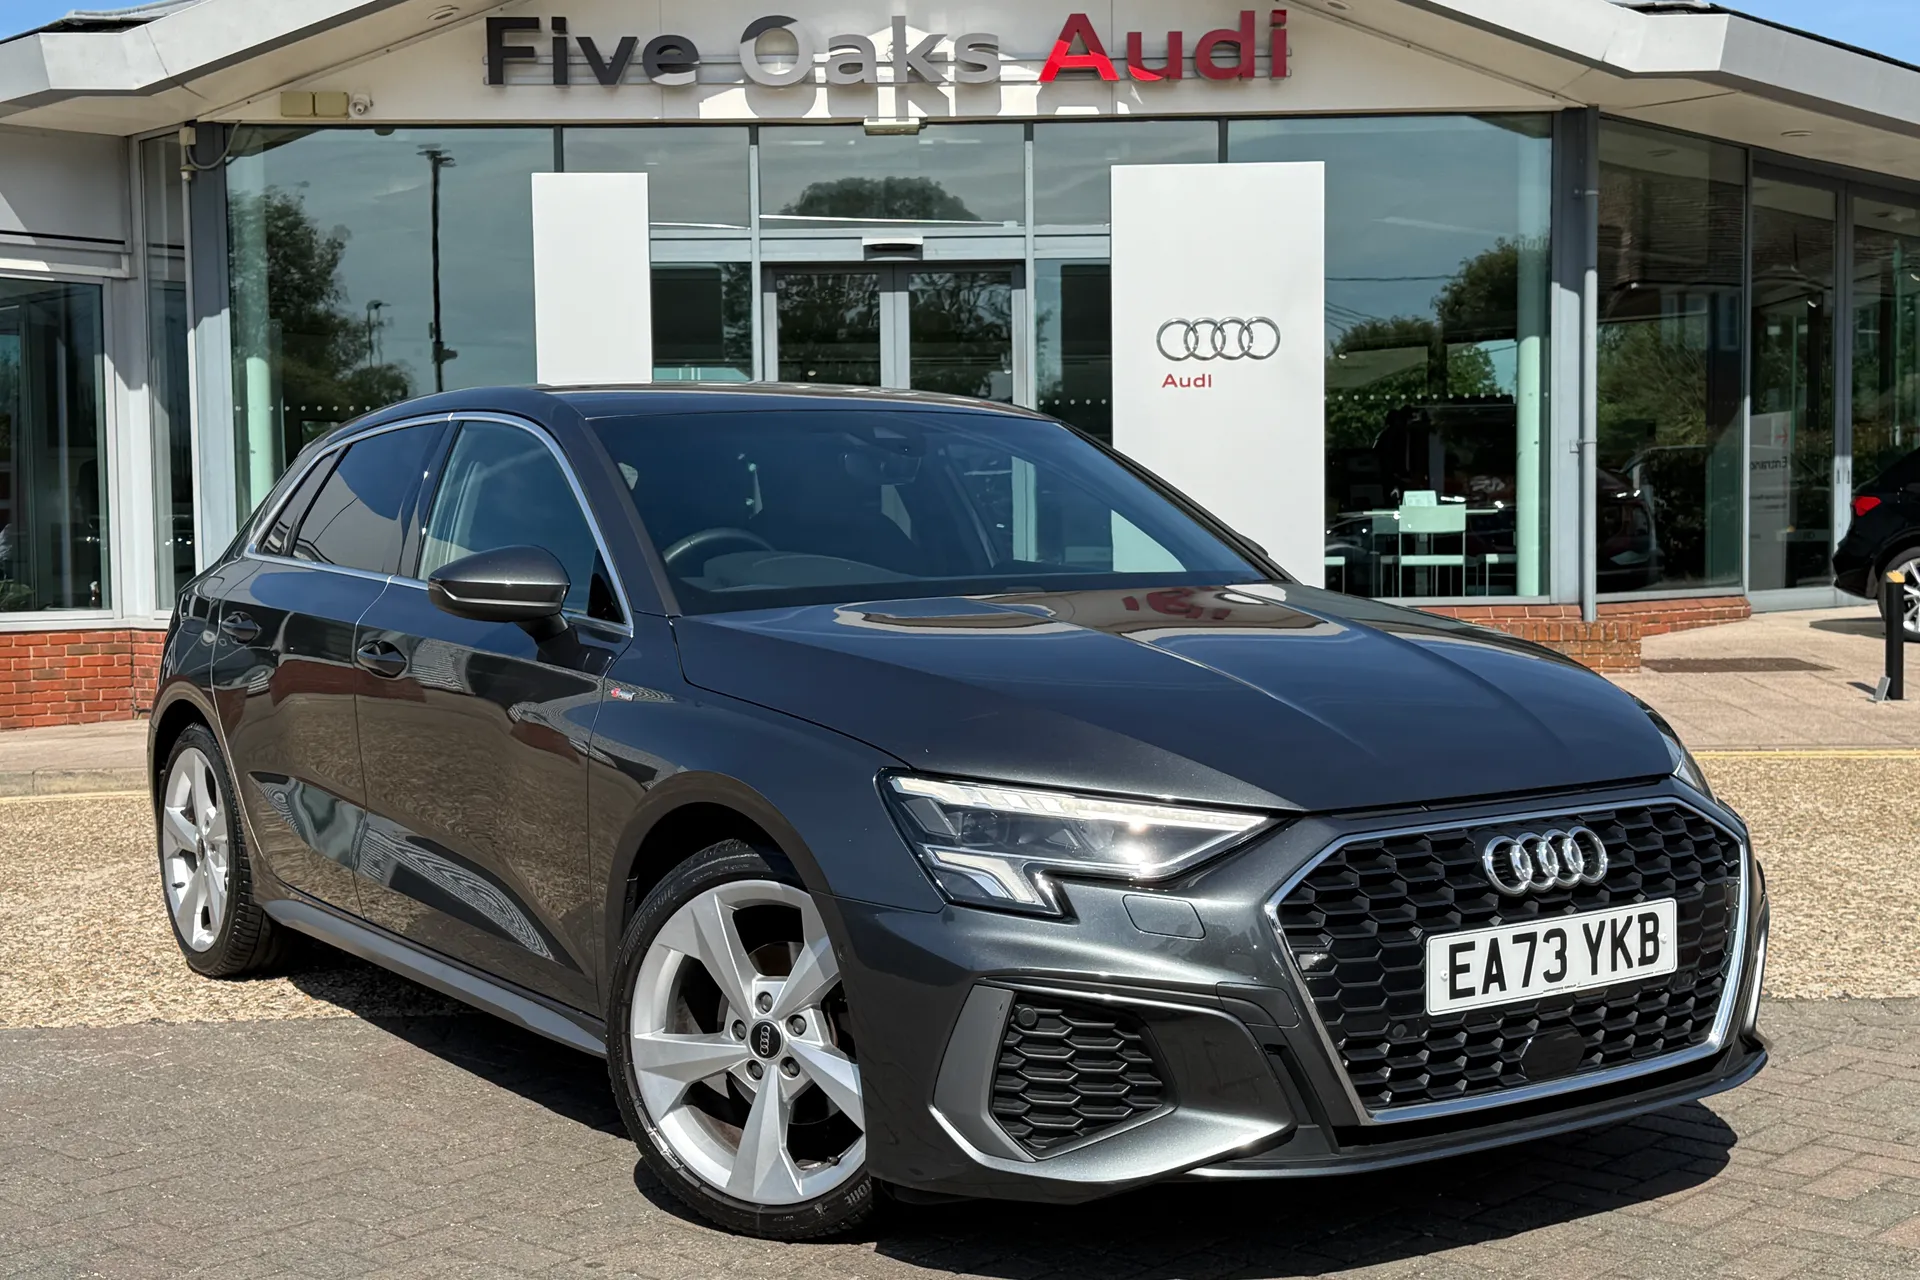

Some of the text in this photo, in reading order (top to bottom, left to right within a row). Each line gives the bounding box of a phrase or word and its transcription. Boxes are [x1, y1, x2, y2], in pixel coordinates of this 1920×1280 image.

[485, 9, 1288, 86] Five Oaks Audi
[1161, 373, 1212, 388] Audi
[1448, 912, 1661, 1000] EA73 YKB
